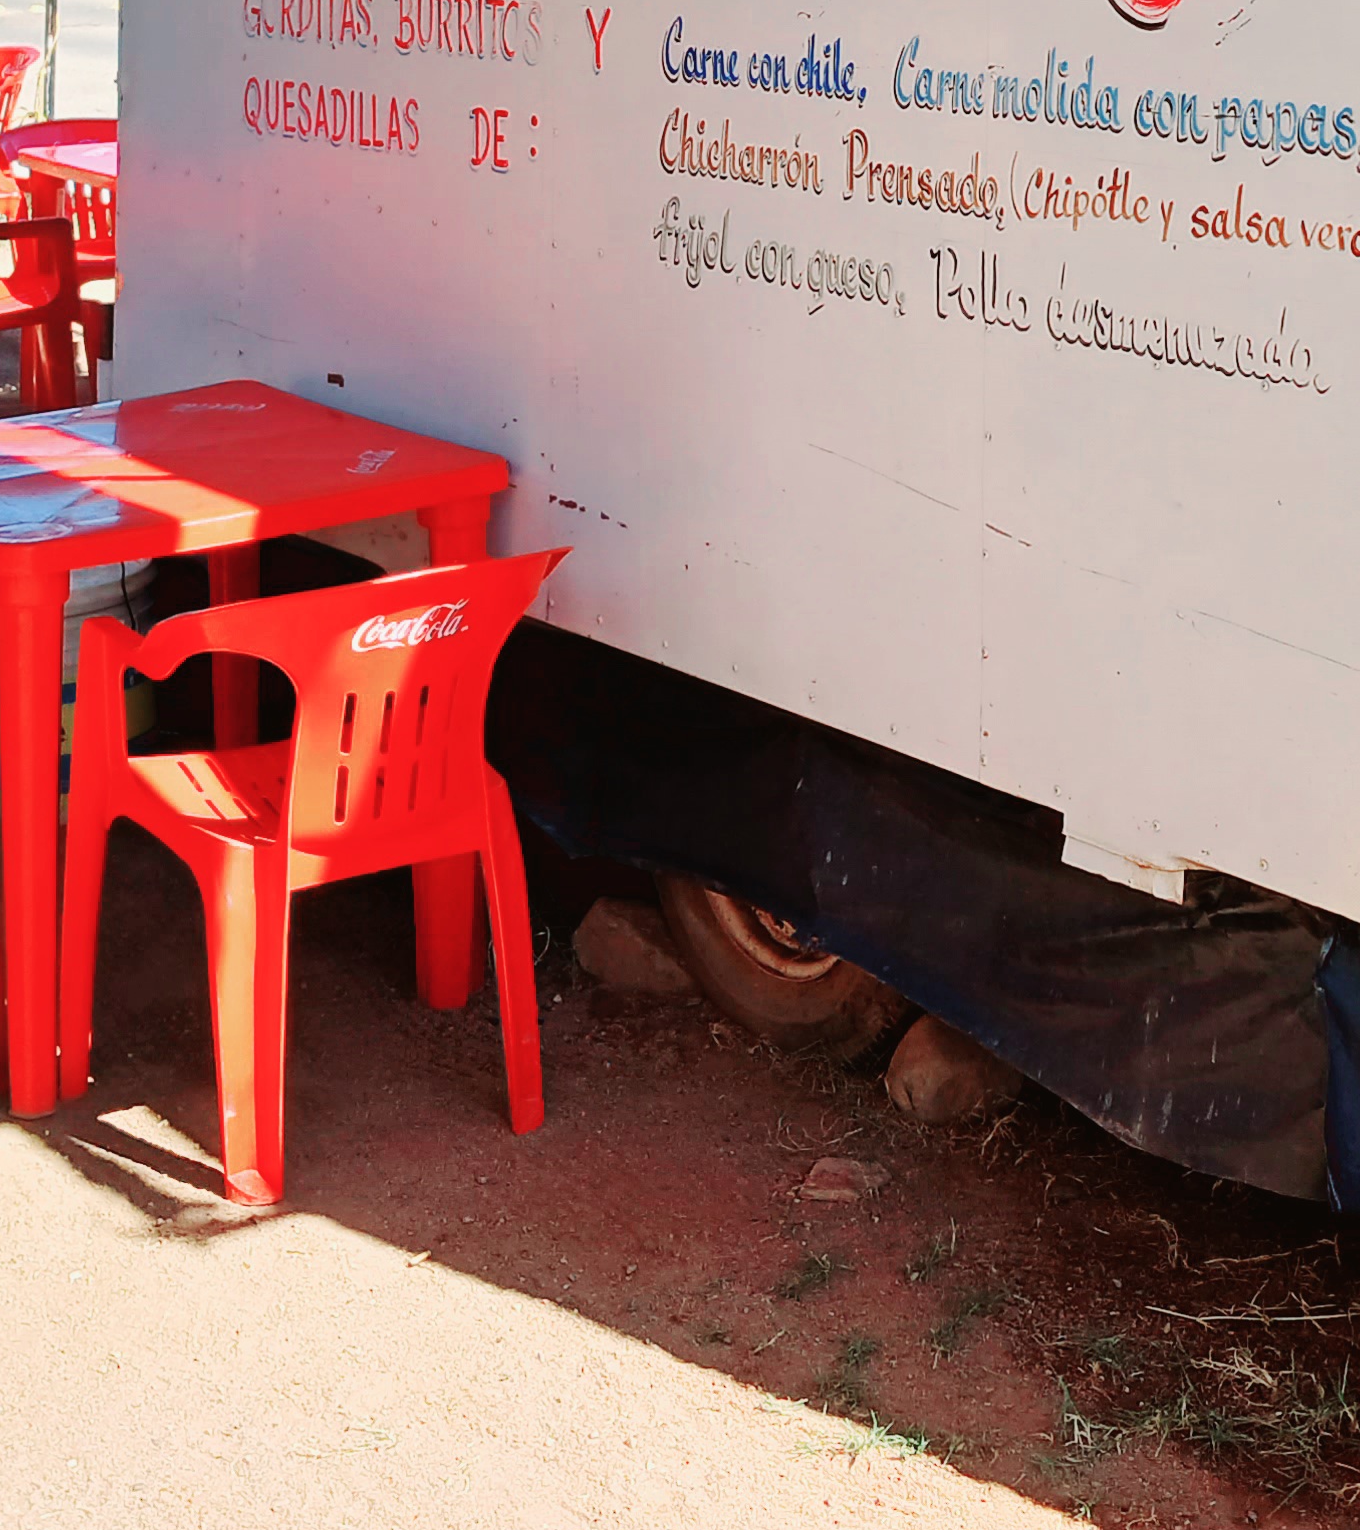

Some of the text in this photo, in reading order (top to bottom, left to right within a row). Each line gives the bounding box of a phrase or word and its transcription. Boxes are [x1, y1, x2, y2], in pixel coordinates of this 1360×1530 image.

[584, 5, 613, 74] Y
[662, 16, 741, 87] Carne
[747, 53, 791, 94] con
[794, 33, 868, 107] chile,
[893, 35, 988, 118] Carne
[990, 47, 1125, 134] molida
[1134, 88, 1209, 144] con
[243, 76, 421, 157] QUESADILLAS
[658, 107, 825, 195] Chicharrón
[1161, 199, 1175, 242] y
[1190, 183, 1292, 249] salsa
[744, 237, 805, 290] con
[930, 246, 1033, 330] Pollo
